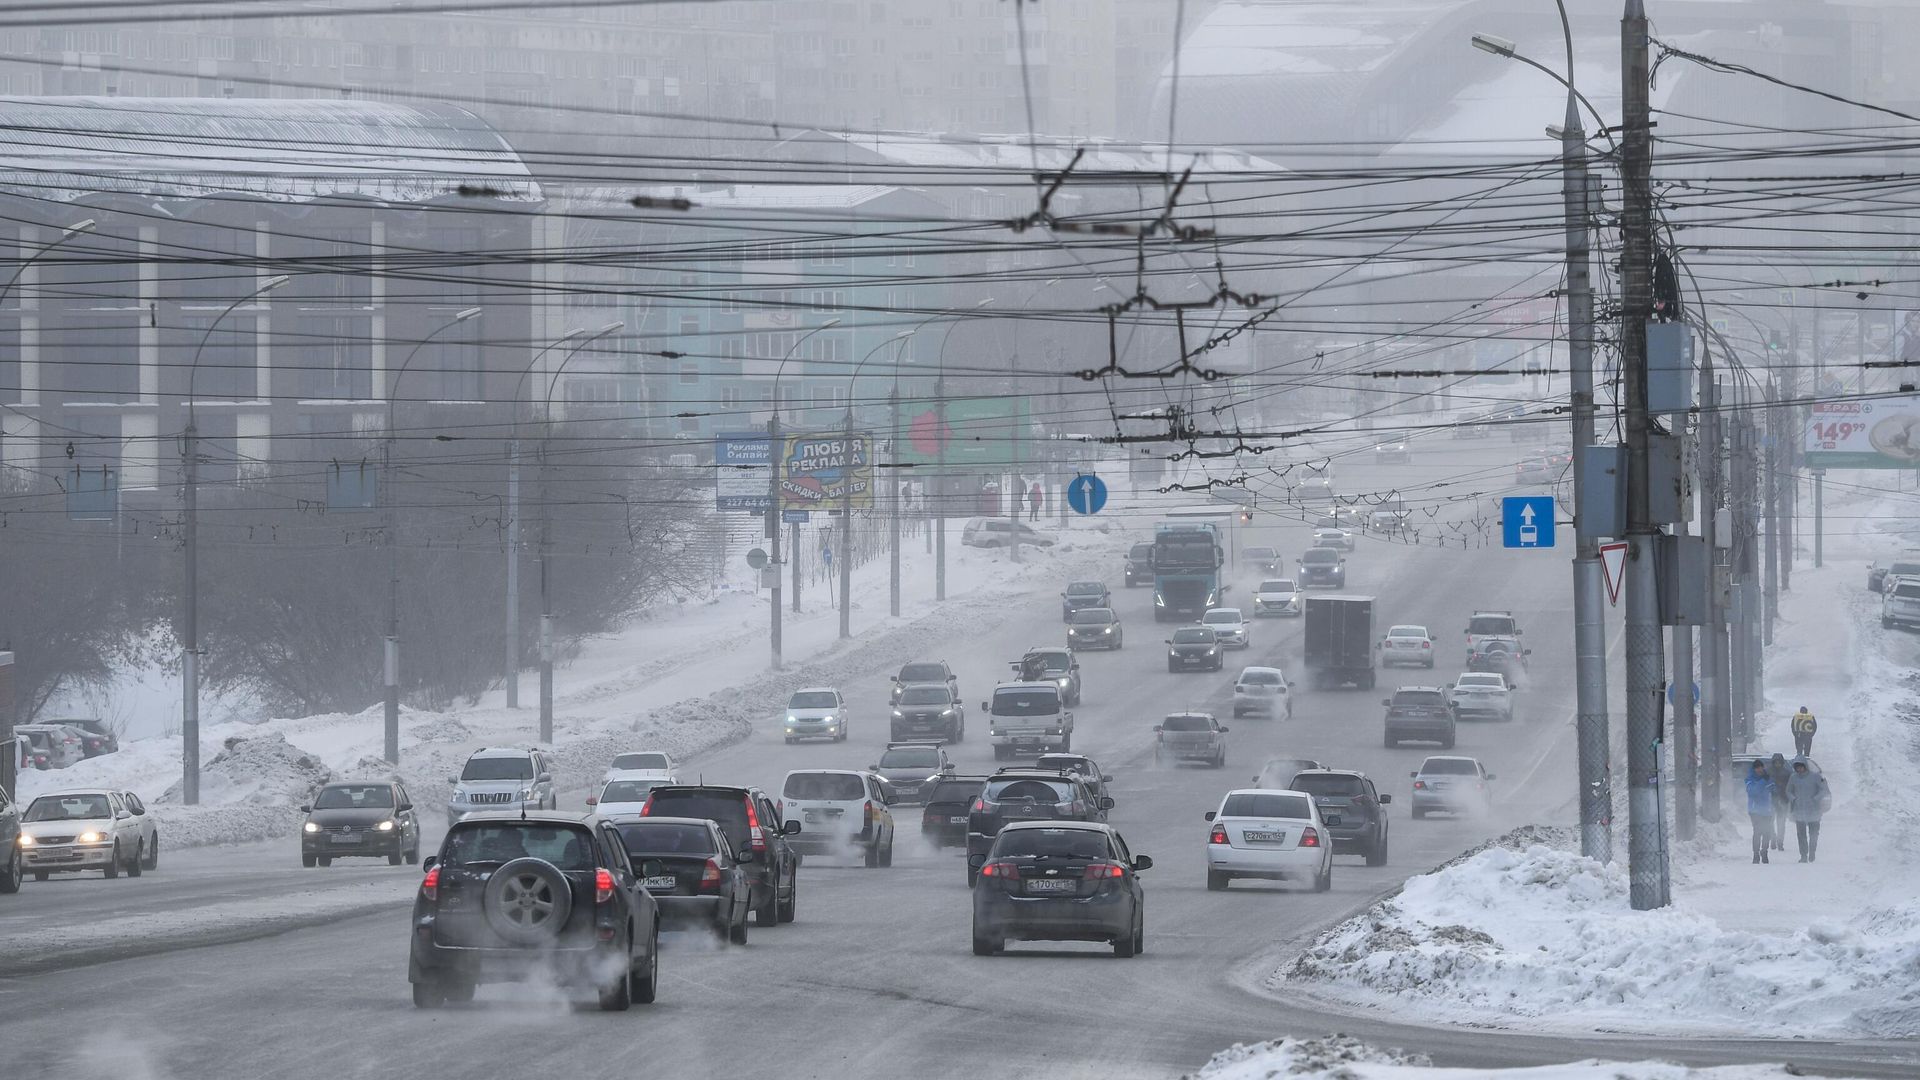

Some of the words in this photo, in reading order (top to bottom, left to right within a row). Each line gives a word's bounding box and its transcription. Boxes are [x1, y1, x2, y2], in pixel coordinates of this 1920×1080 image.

[1823, 403, 1860, 412] SPAR
[1813, 422, 1852, 441] 149
[726, 443, 769, 451] Реклама
[803, 439, 862, 457] ЛЮБЯ
[782, 481, 821, 501] СКИДКИ
[726, 499, 742, 507] 227
